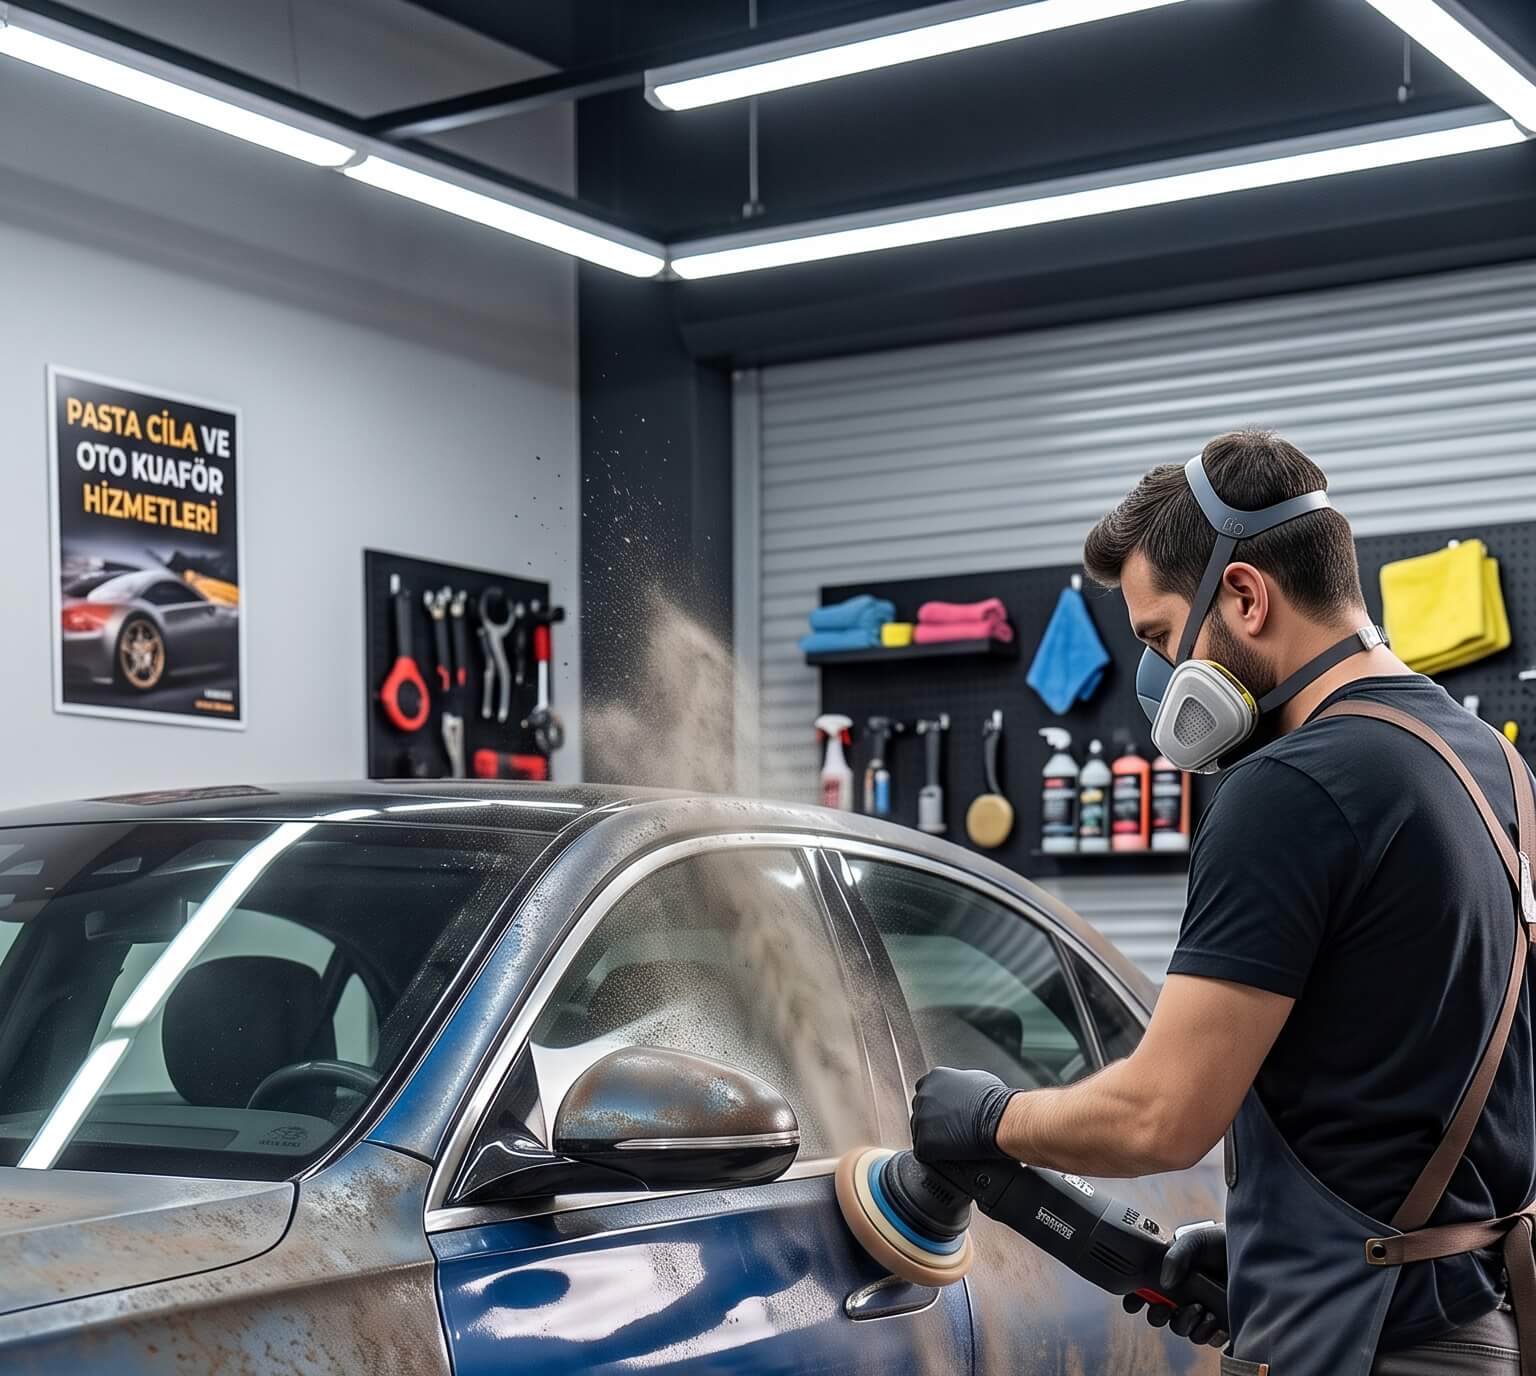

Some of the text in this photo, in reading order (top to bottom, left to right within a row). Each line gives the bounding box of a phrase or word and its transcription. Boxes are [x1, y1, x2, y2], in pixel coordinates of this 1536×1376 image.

[67, 397, 231, 458] PASTA CİLA VE
[76, 441, 224, 496] OTO KUAFÖR
[83, 480, 218, 534] HİZMETLERİ
